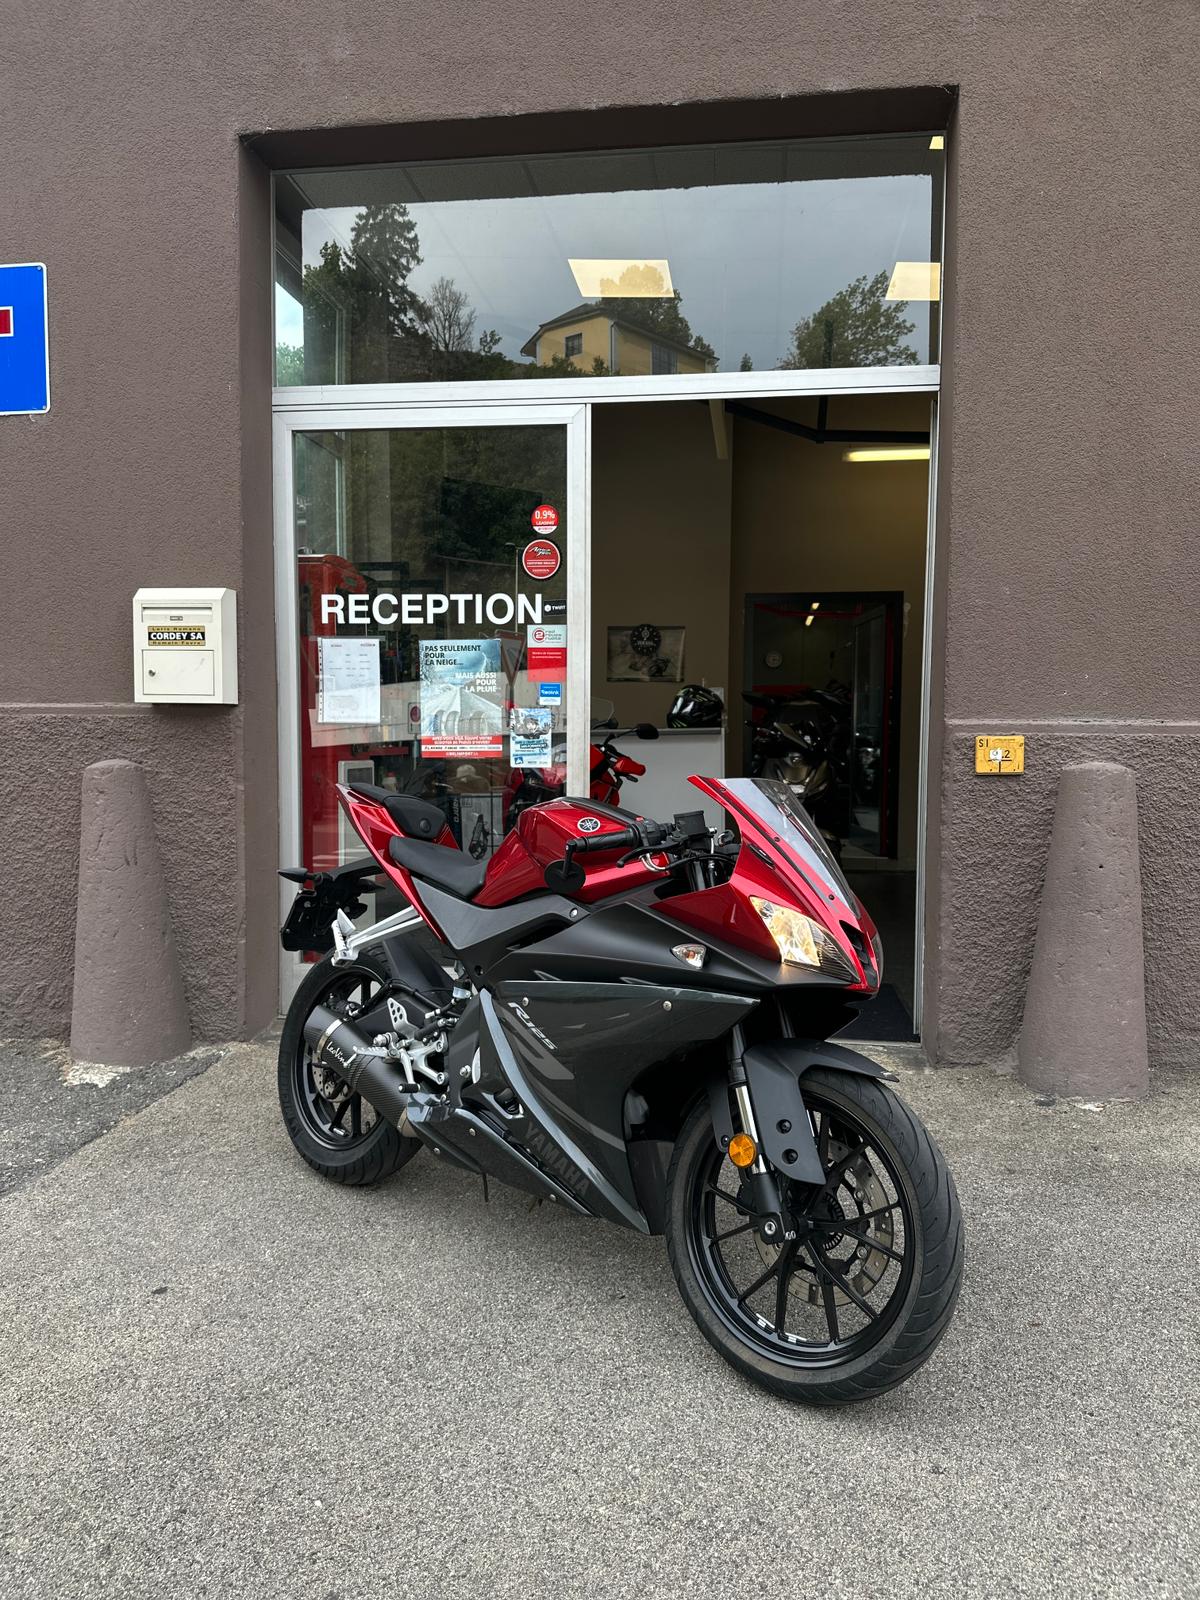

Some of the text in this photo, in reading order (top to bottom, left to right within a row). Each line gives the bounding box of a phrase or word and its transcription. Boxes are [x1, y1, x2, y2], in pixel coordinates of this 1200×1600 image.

[534, 510, 556, 519] 0.9%
[321, 593, 542, 625] RECEPTION
[151, 632, 203, 640] CORDEY SA
[526, 1121, 590, 1197] YAMAHA
